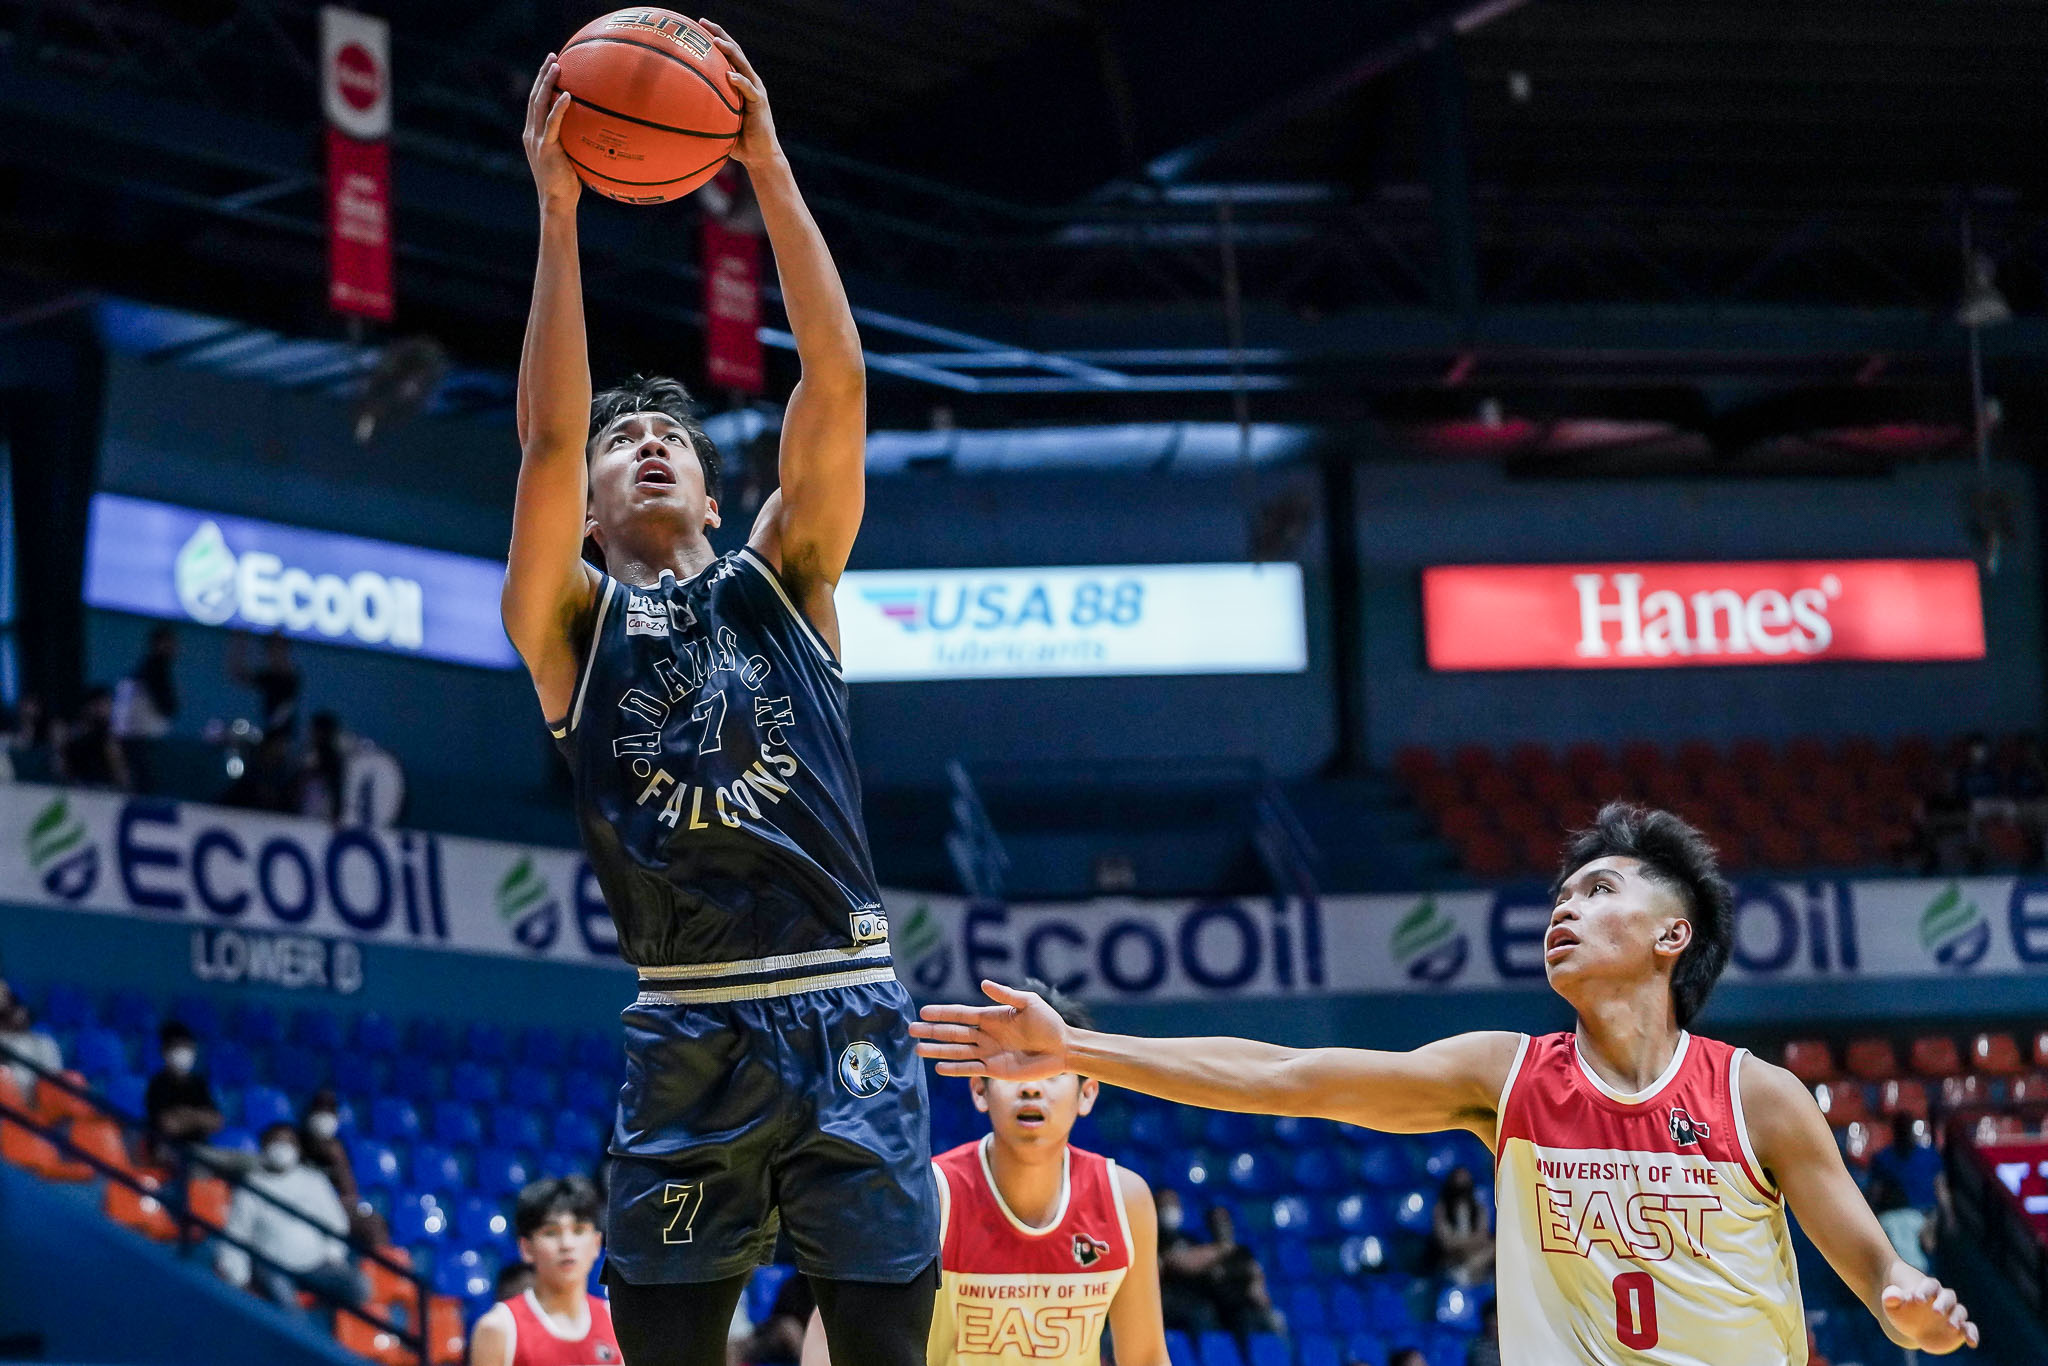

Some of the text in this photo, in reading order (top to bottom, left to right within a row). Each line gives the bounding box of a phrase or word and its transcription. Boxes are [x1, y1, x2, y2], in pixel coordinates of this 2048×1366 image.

[605, 24, 704, 61] CHAMPIONSHIP
[608, 12, 712, 57] ELITE
[926, 579, 1145, 630] USA 88
[1572, 572, 1833, 658] Hanes
[936, 639, 1107, 665] lubricants
[613, 626, 795, 758] ADAMSON
[692, 690, 727, 756] 7
[636, 744, 797, 829] FALCONS
[118, 798, 449, 939] EcoOil
[191, 931, 328, 986] LOWER
[964, 892, 1326, 995] EcoOil
[1536, 1158, 1718, 1185] UNIVERSITY OF THE
[664, 1182, 703, 1244] 7
[1536, 1183, 1722, 1261] EAST
[958, 1281, 1109, 1299] UNIVERSITY OF THE
[1612, 1271, 1658, 1350] 0
[956, 1302, 1107, 1358] EAST
